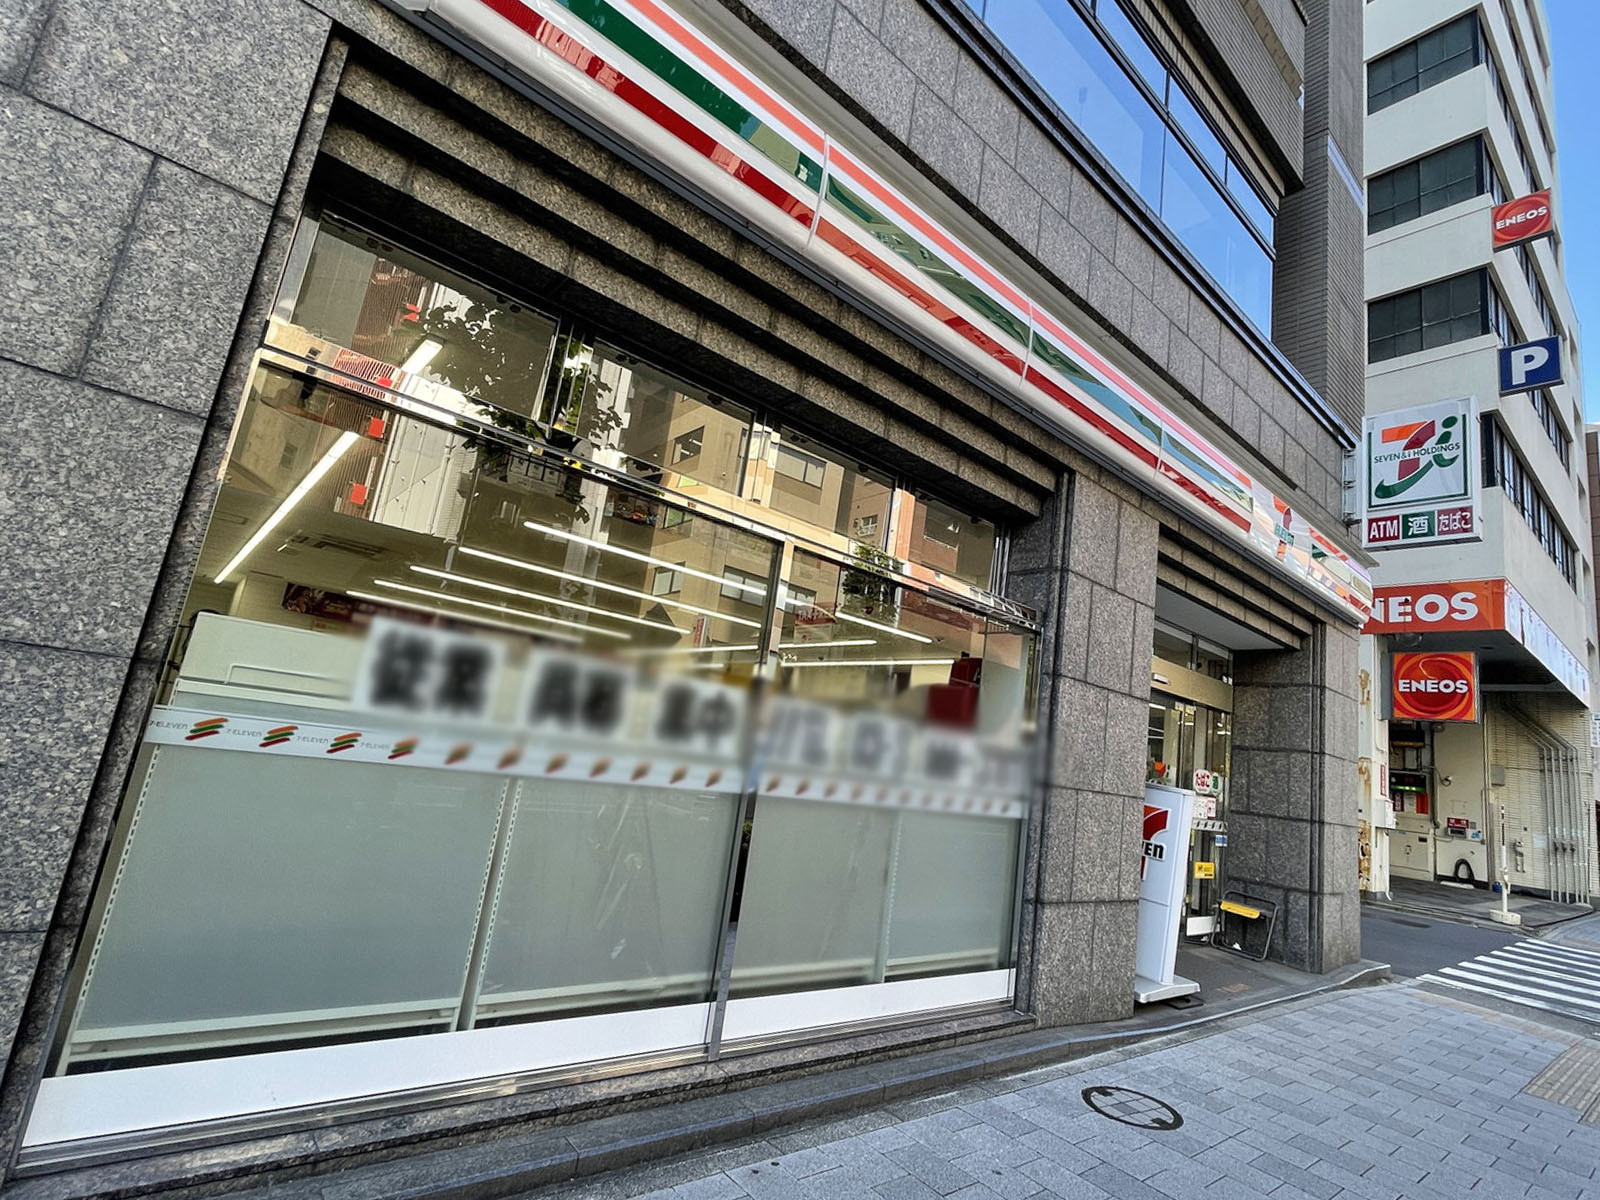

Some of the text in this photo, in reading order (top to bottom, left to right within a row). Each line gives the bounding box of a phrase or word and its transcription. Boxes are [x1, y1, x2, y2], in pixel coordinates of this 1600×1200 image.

[1496, 205, 1548, 230] ENEOS
[1511, 346, 1549, 385] P
[1413, 442, 1460, 456] HOLDINGS
[1369, 520, 1398, 540] ATM
[1408, 516, 1428, 536] 酒
[1438, 511, 1472, 532] たばこ
[1370, 591, 1479, 623] NEOS
[1398, 679, 1469, 694] ENEOS
